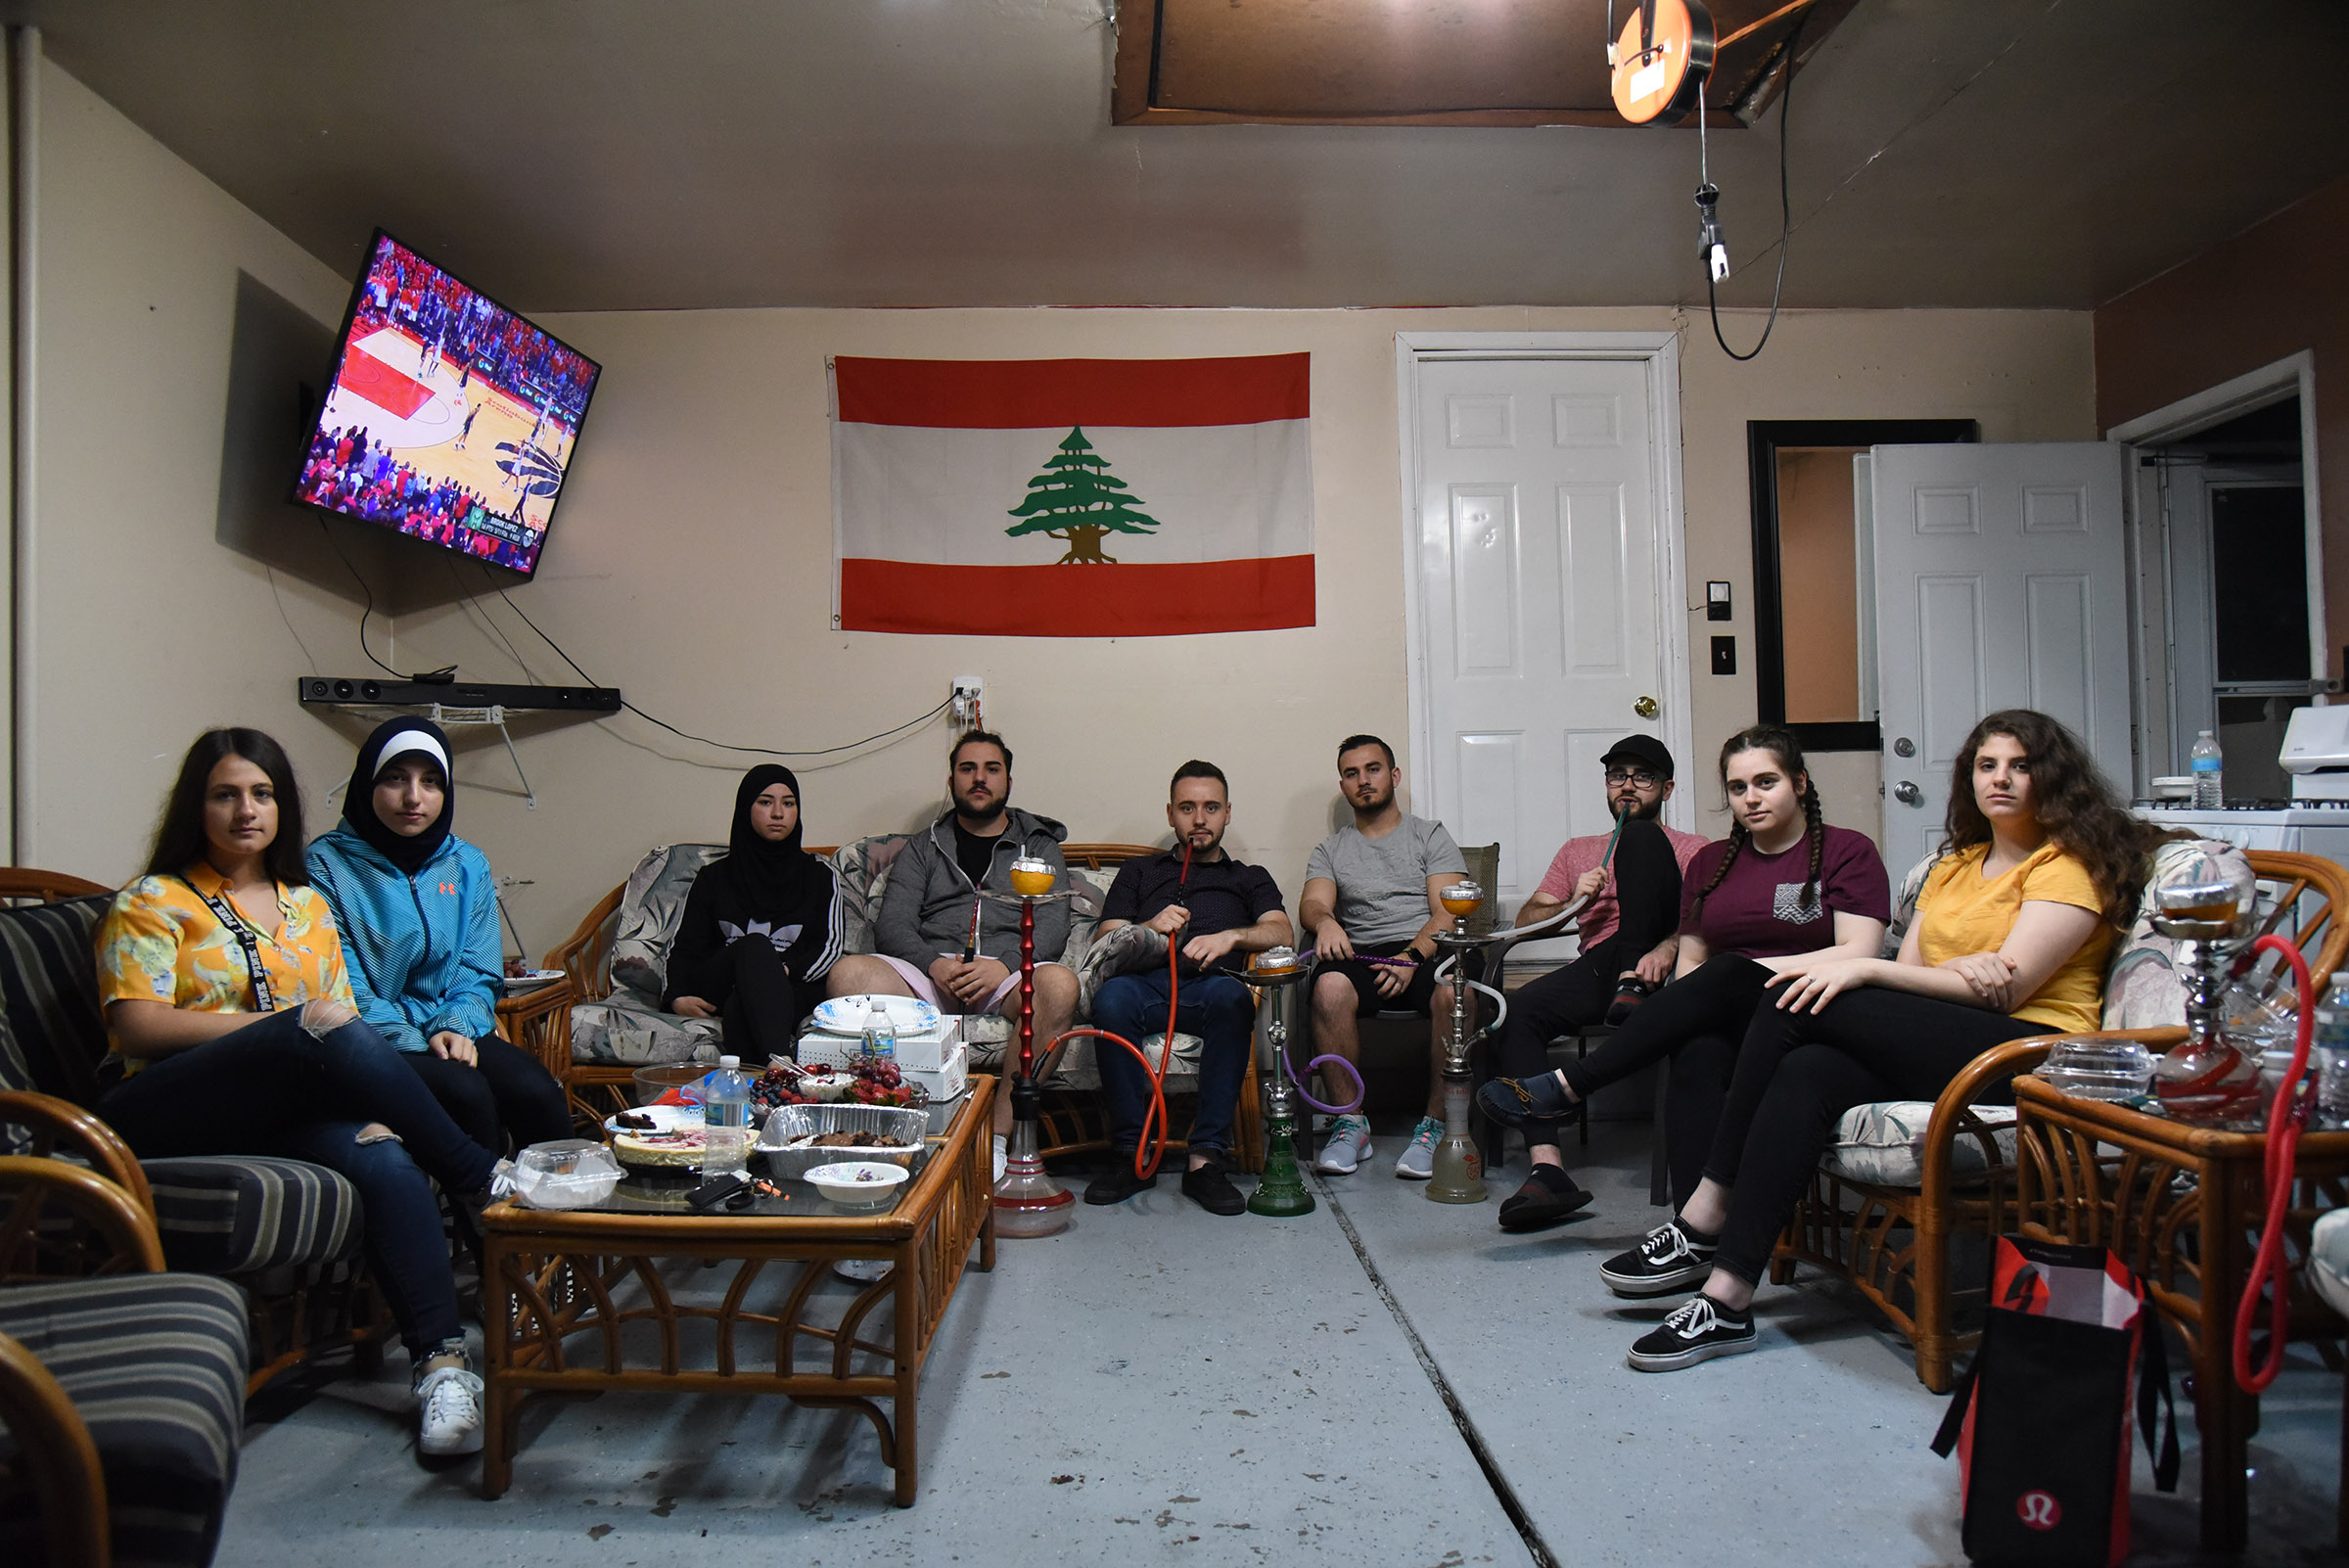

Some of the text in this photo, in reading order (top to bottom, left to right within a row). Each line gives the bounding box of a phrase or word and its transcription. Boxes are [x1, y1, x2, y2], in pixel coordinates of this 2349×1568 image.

[213, 905, 237, 927] PINK
[249, 948, 272, 1011] PINK PINK
